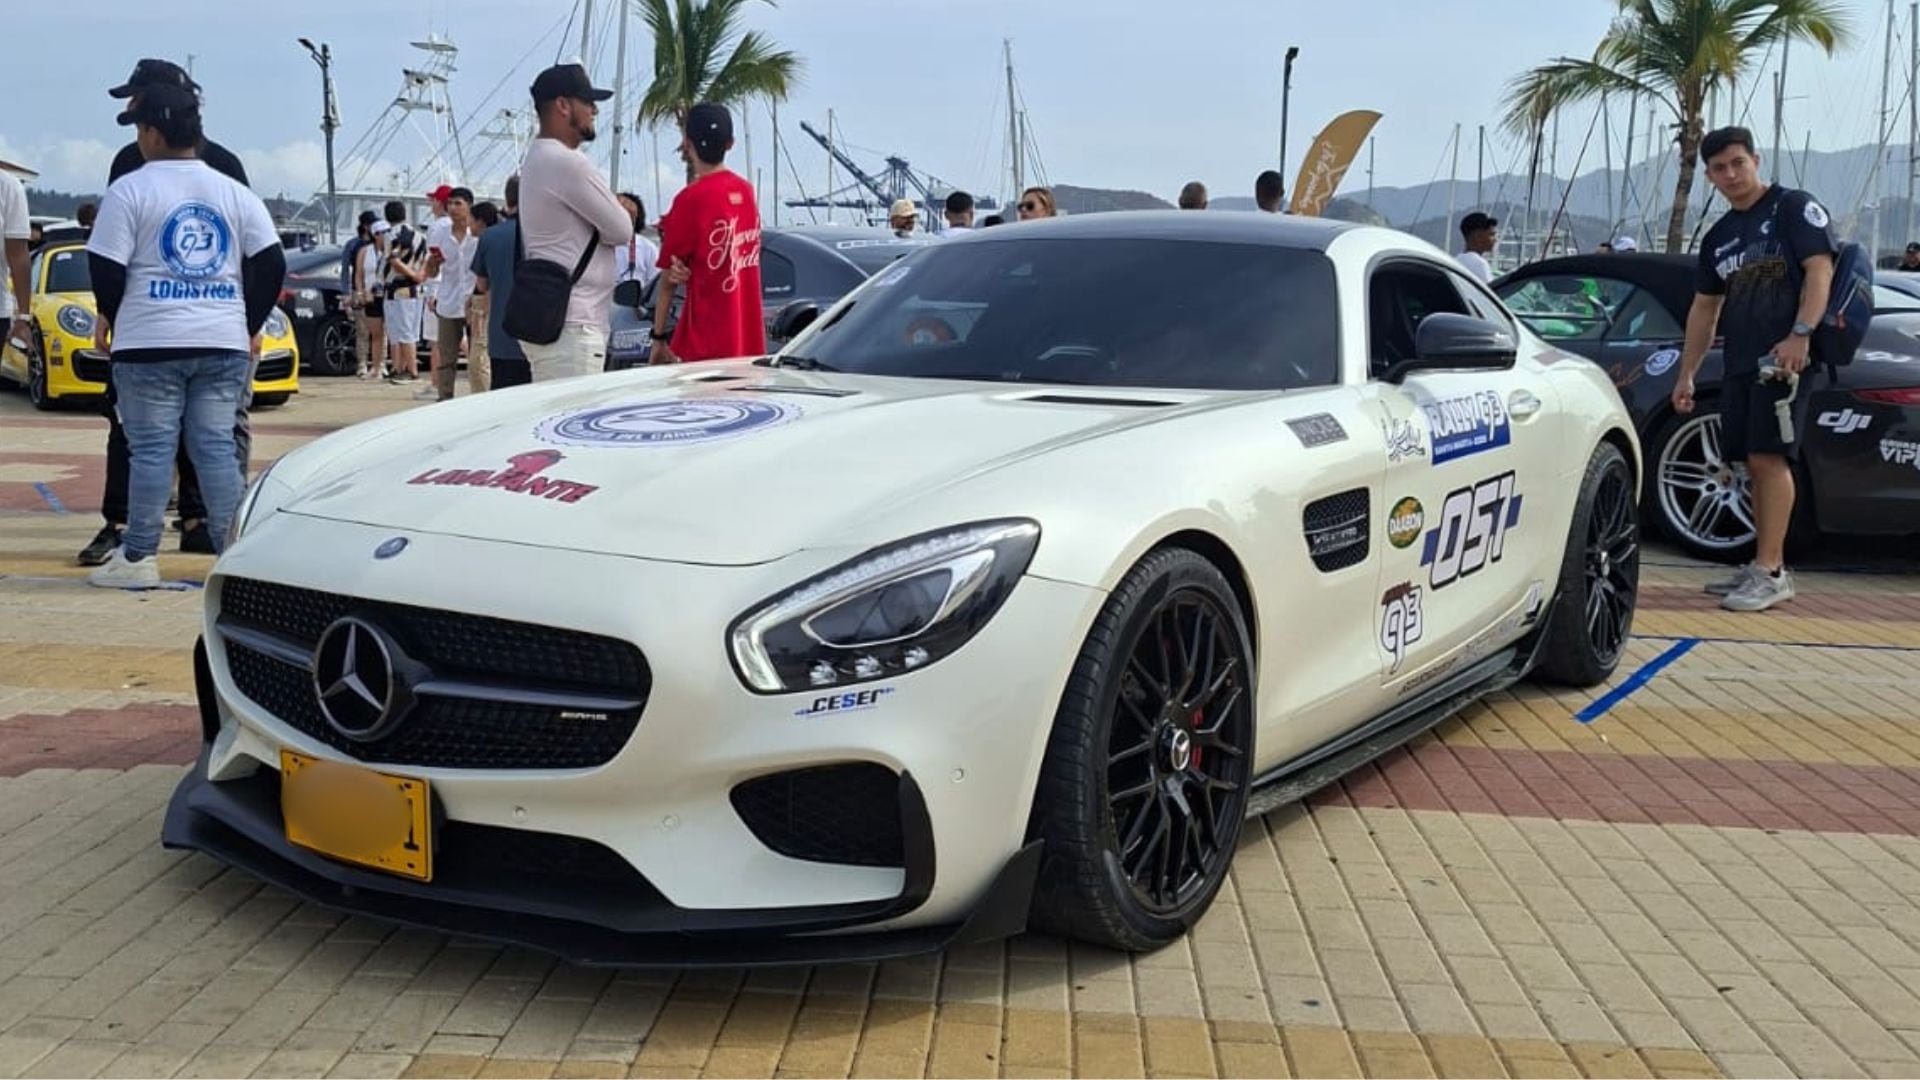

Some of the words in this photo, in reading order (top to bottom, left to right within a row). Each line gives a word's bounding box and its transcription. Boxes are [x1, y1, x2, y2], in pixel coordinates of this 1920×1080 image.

[1427, 396, 1478, 439] RALLY
[1817, 408, 1872, 433] dji
[1381, 584, 1423, 676] 93
